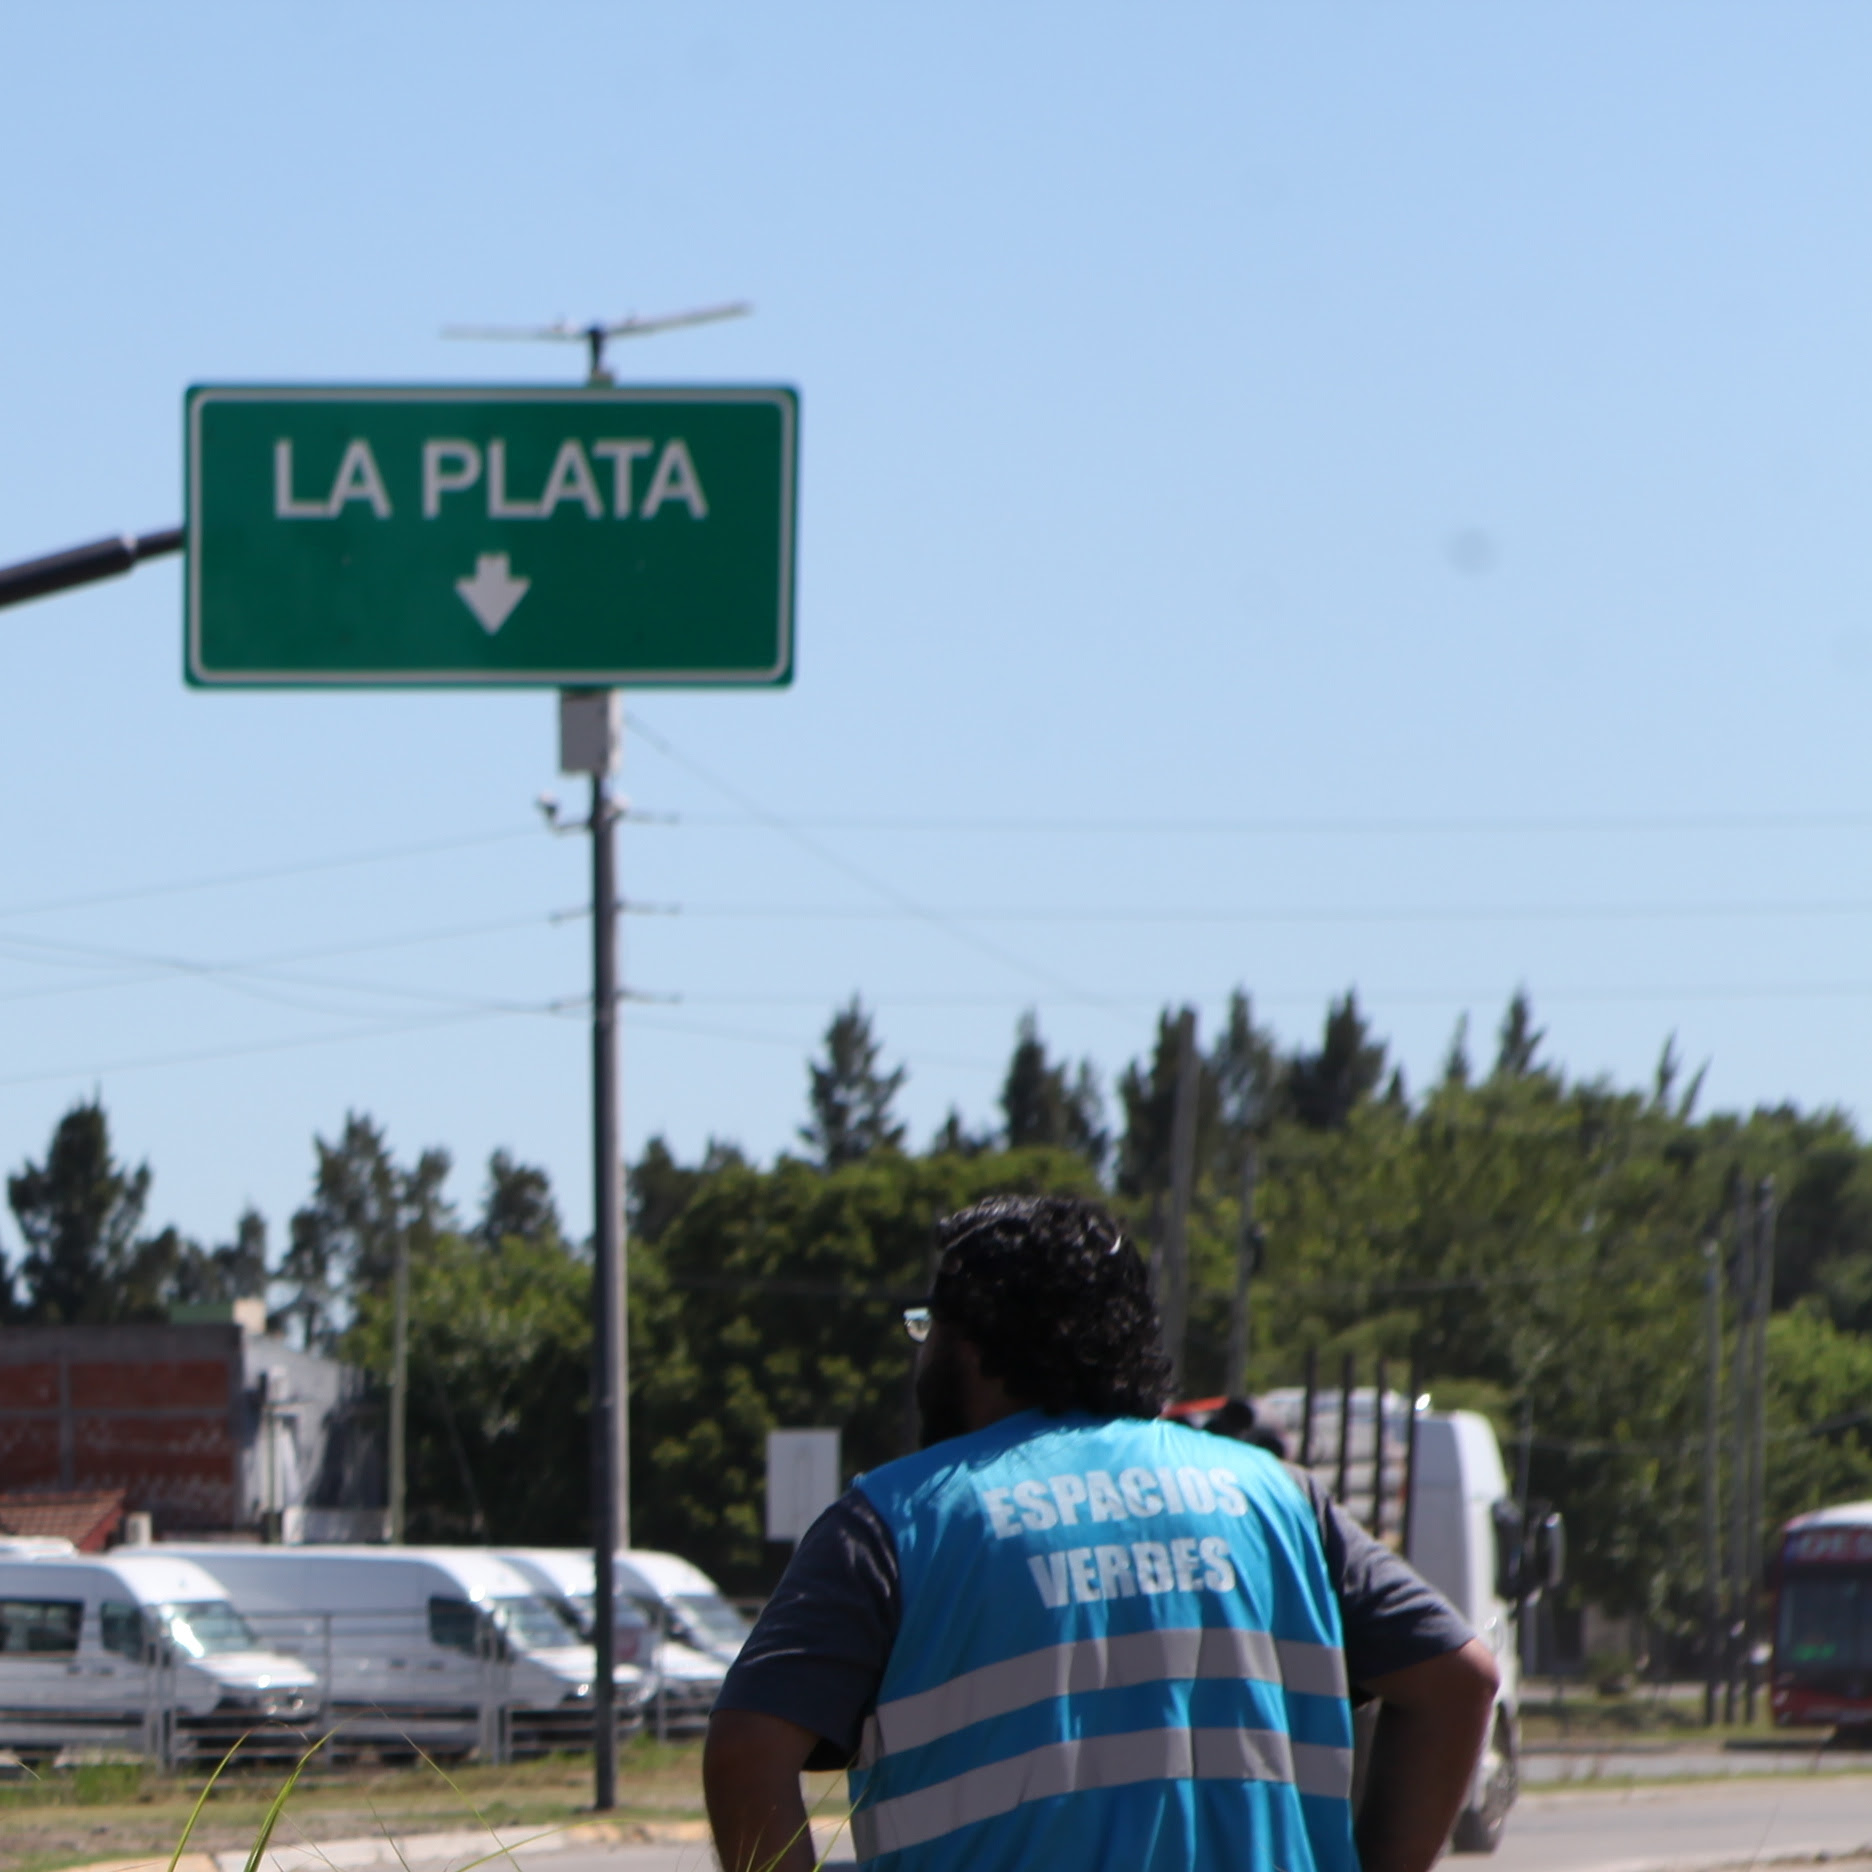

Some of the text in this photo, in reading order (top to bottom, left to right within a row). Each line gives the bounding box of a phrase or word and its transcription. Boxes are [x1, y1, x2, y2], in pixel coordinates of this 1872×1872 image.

[274, 436, 709, 519] LA PLATA
[981, 1466, 1249, 1540] ESPACIOS
[1026, 1536, 1236, 1609] VERDES
